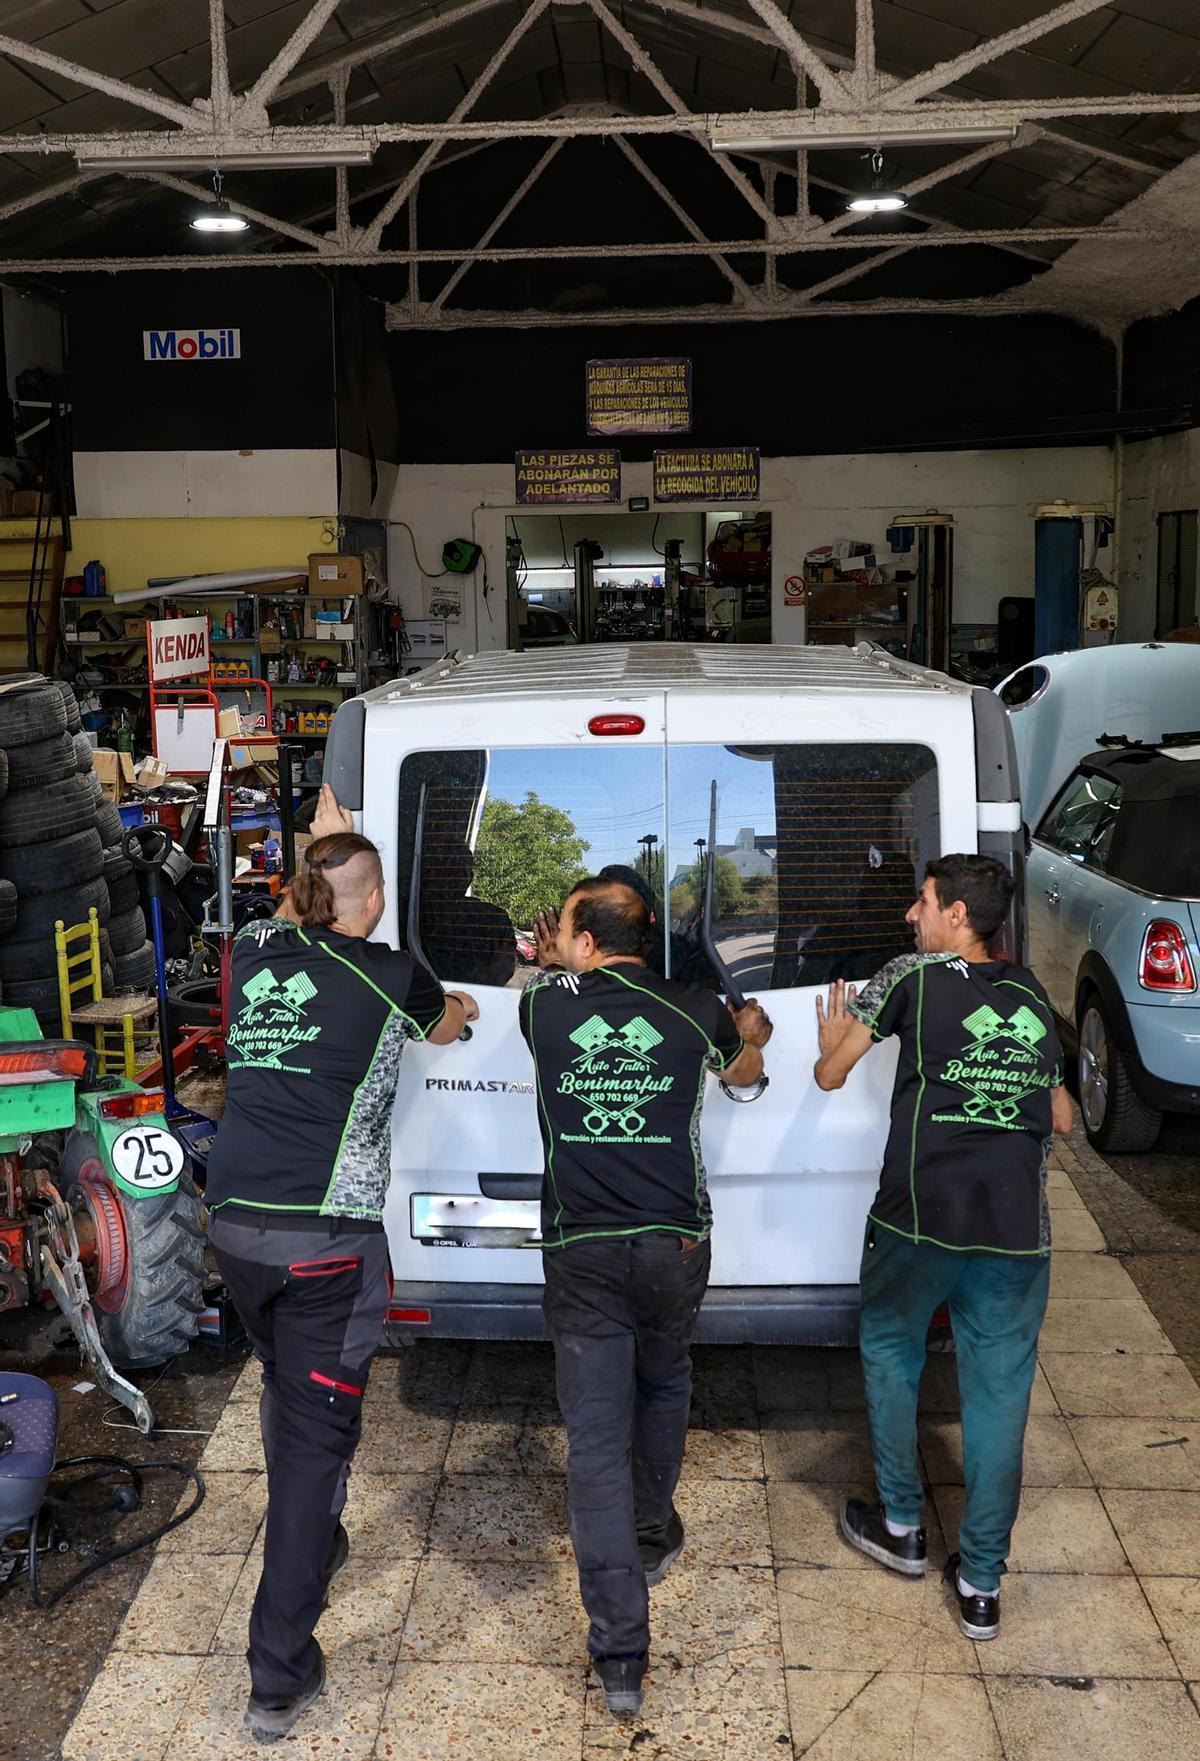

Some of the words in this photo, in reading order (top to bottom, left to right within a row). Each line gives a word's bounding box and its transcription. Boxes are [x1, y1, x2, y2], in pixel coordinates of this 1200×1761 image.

[150, 330, 234, 358] Mobil
[522, 455, 545, 466] LAS
[549, 454, 594, 466] PIEZAS
[598, 454, 614, 465] SE
[657, 455, 665, 472] LA
[667, 454, 699, 472] FACTURA
[701, 453, 711, 471] SE
[748, 453, 754, 470] A
[518, 467, 588, 480] ABONARÁN
[592, 468, 618, 480] POR
[525, 483, 610, 495] ADELANTADO
[657, 477, 666, 494] LA
[667, 476, 704, 494] RECOGIDA
[705, 476, 719, 493] DEL
[155, 632, 205, 664] KENDA
[240, 1007, 264, 1025] Auto
[227, 1023, 322, 1045] Benimarfull
[255, 1041, 267, 1050] 702
[268, 1041, 282, 1050] 669
[964, 1045, 1000, 1063] Auto
[1002, 1047, 1038, 1065] Taller
[575, 1056, 610, 1075] Auto
[613, 1057, 650, 1075] Taller
[425, 1078, 535, 1095] PRIMASTAR
[556, 1071, 675, 1095] Benimarfull
[975, 1081, 990, 1090] 650
[991, 1082, 1006, 1092] 702
[1007, 1084, 1023, 1094] 669
[589, 1093, 605, 1102] 650
[606, 1093, 621, 1102] 702
[623, 1093, 639, 1102] 669
[560, 1133, 590, 1143] Reparación
[595, 1134, 634, 1143] restauración
[634, 1135, 642, 1143] de
[643, 1135, 672, 1143] vehículos
[123, 1133, 173, 1181] 25
